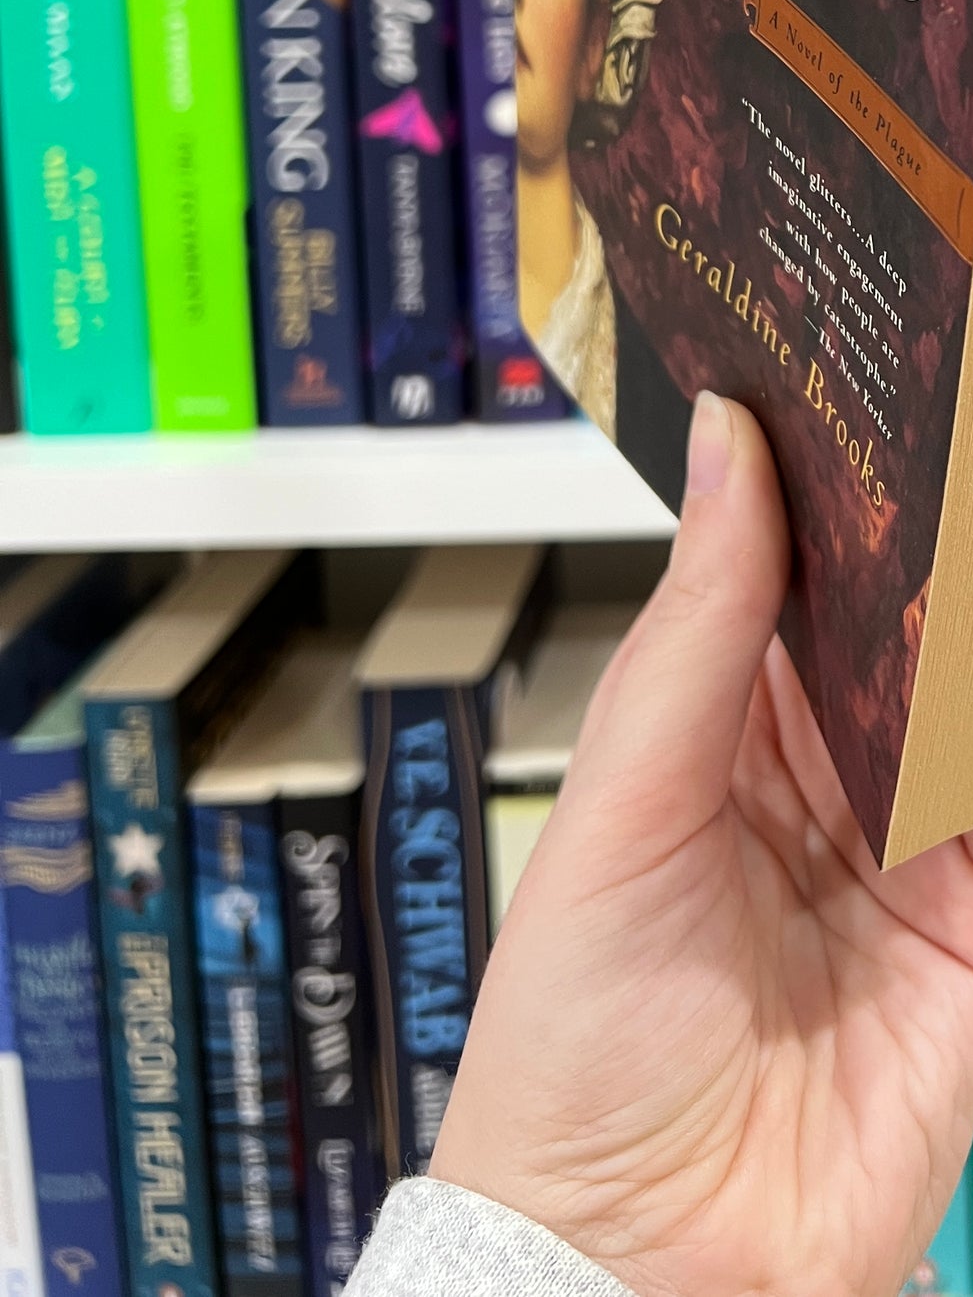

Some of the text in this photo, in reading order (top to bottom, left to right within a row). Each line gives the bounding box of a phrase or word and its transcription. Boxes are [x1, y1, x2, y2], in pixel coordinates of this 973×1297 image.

[259, 29, 330, 193] KING
[769, 10, 923, 177] A Novel of the Plague
[759, 226, 804, 284] changed
[807, 275, 822, 307] by
[768, 160, 905, 333] imaginative engagement
[775, 135, 807, 177] novel
[879, 250, 908, 297] deep
[785, 219, 900, 370] with how people are
[655, 202, 886, 507] Geraldine Brooks
[838, 353, 861, 393] New
[862, 387, 893, 441] Yorker
[388, 806, 467, 1057] SCHWAB
[133, 1111, 193, 1268] HEALER
